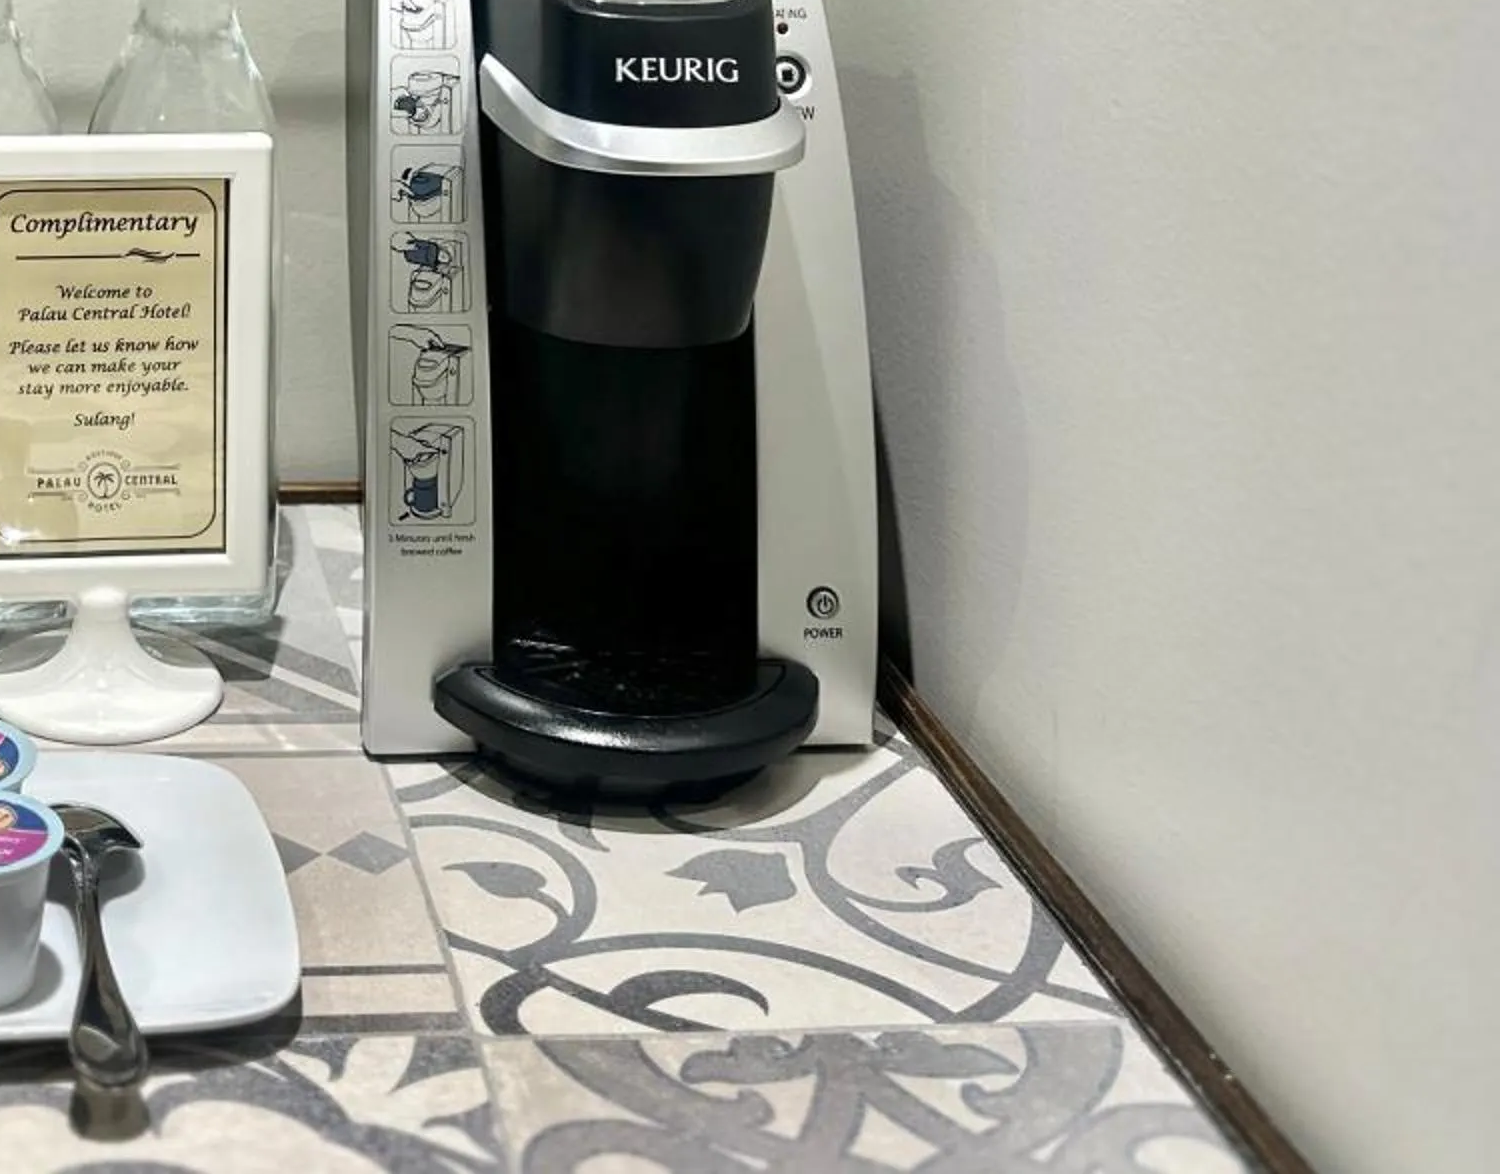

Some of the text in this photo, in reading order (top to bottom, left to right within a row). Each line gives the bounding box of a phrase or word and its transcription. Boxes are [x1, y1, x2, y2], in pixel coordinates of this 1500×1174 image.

[615, 57, 739, 83] KEURIG
[11, 212, 198, 239] Complimentary
[57, 284, 153, 299] Welcome to
[18, 306, 67, 322] Palau
[72, 304, 138, 321] Central
[9, 336, 199, 355] Please let us know how
[28, 358, 182, 376] we can make your
[18, 377, 189, 400] stay more enjoyable.
[73, 411, 136, 430] Sulang!
[37, 475, 178, 488] PALAU CENTRAL
[803, 627, 843, 639] POWER
